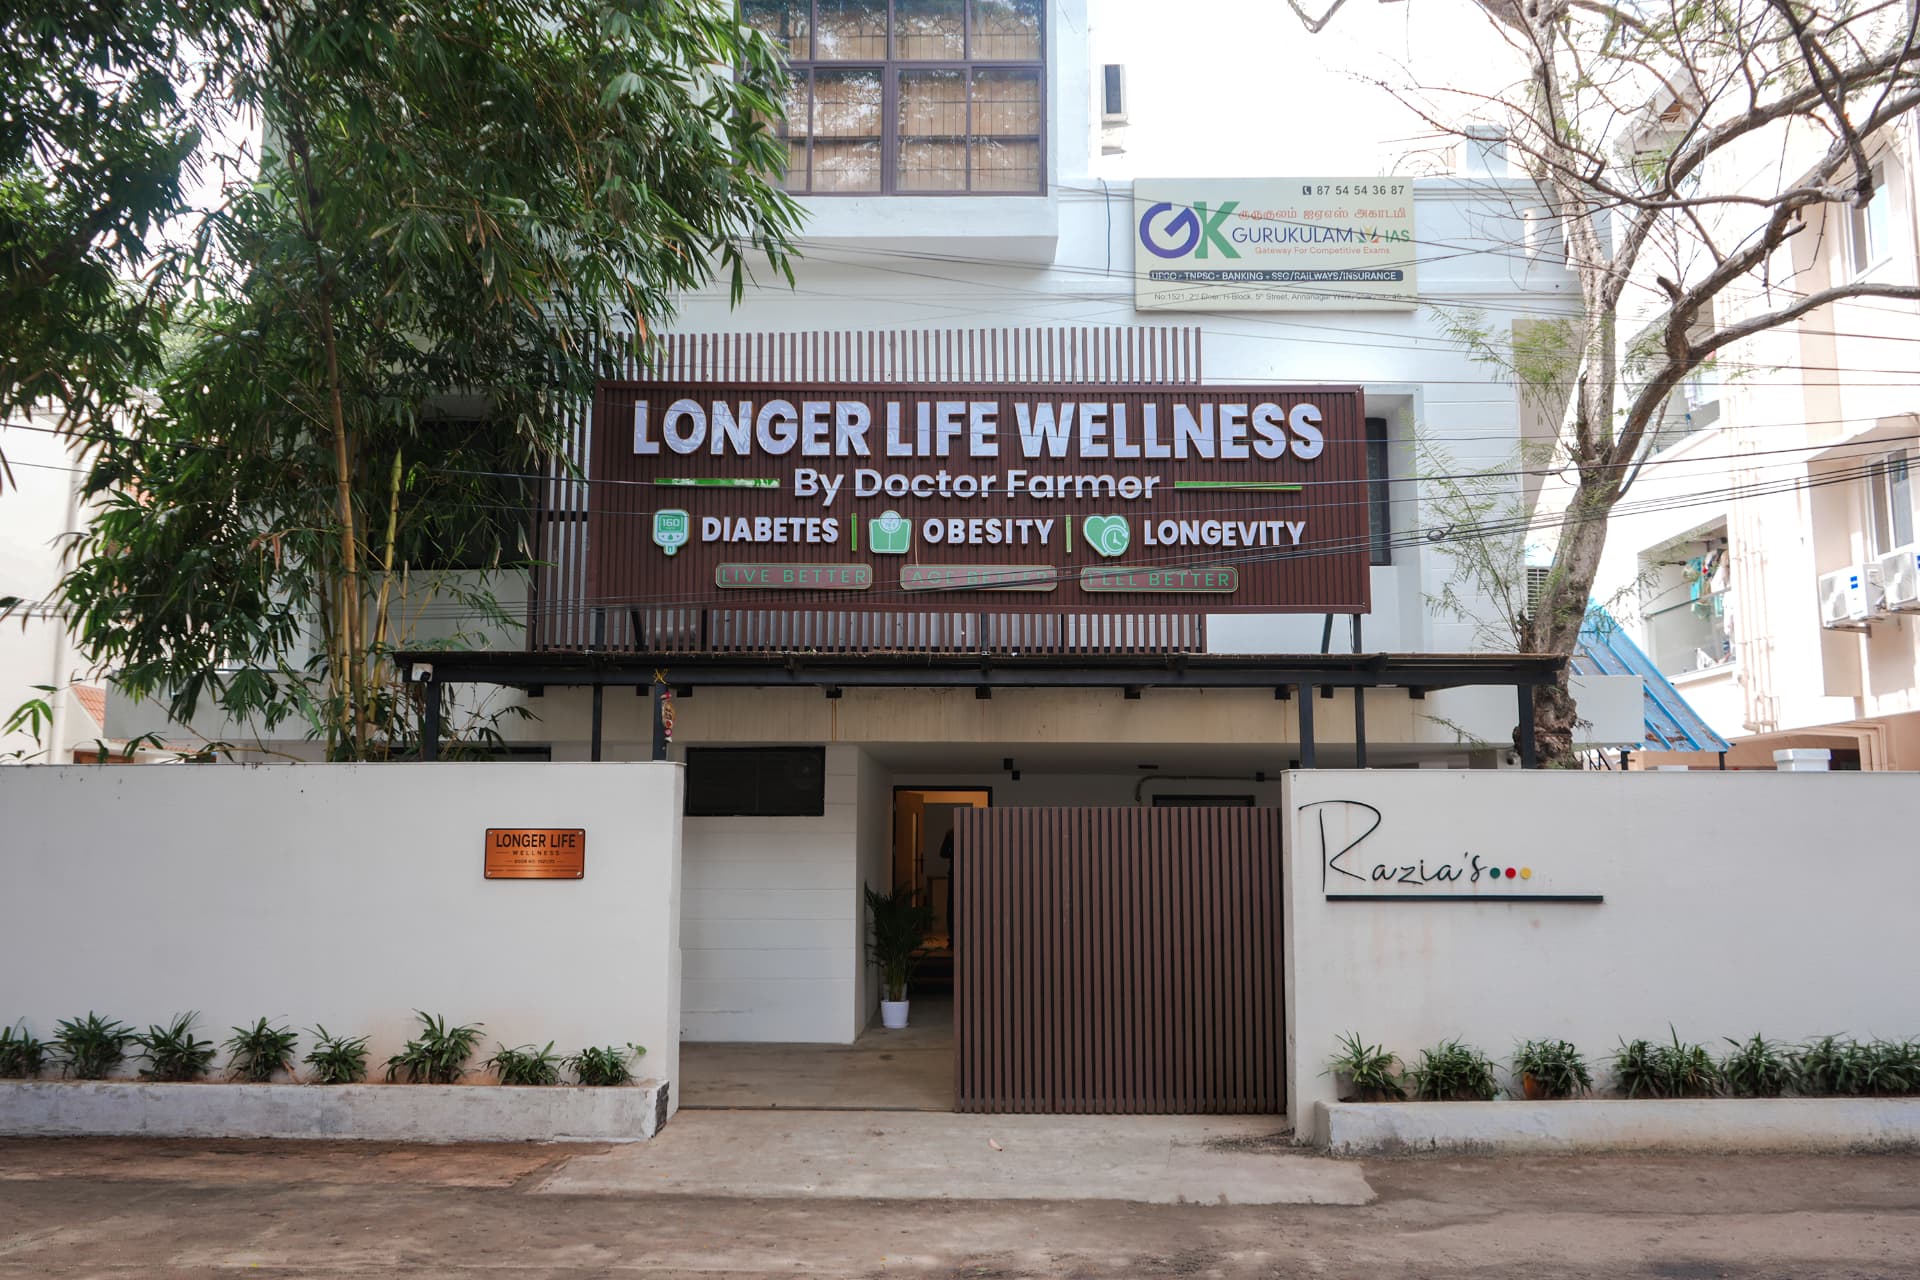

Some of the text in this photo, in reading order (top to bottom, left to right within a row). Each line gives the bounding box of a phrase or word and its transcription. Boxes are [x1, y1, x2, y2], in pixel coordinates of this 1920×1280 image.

[1316, 185, 1405, 196] 87 54 54 36 87
[1232, 227, 1410, 243] GURUKULAM IAS
[1255, 246, 1390, 255] Gateway For Competitive Exams
[1222, 271, 1263, 280] BANKING
[632, 398, 1325, 460] LONGER LIFE WELLNESS
[794, 468, 1161, 507] By Doctor Farmer
[702, 516, 1307, 546] DIABETES OBESITY LONGEVITY
[722, 569, 867, 583] LIVE BETTER
[1148, 572, 1230, 586] BETTER
[496, 833, 577, 848] LONGER LIFE
